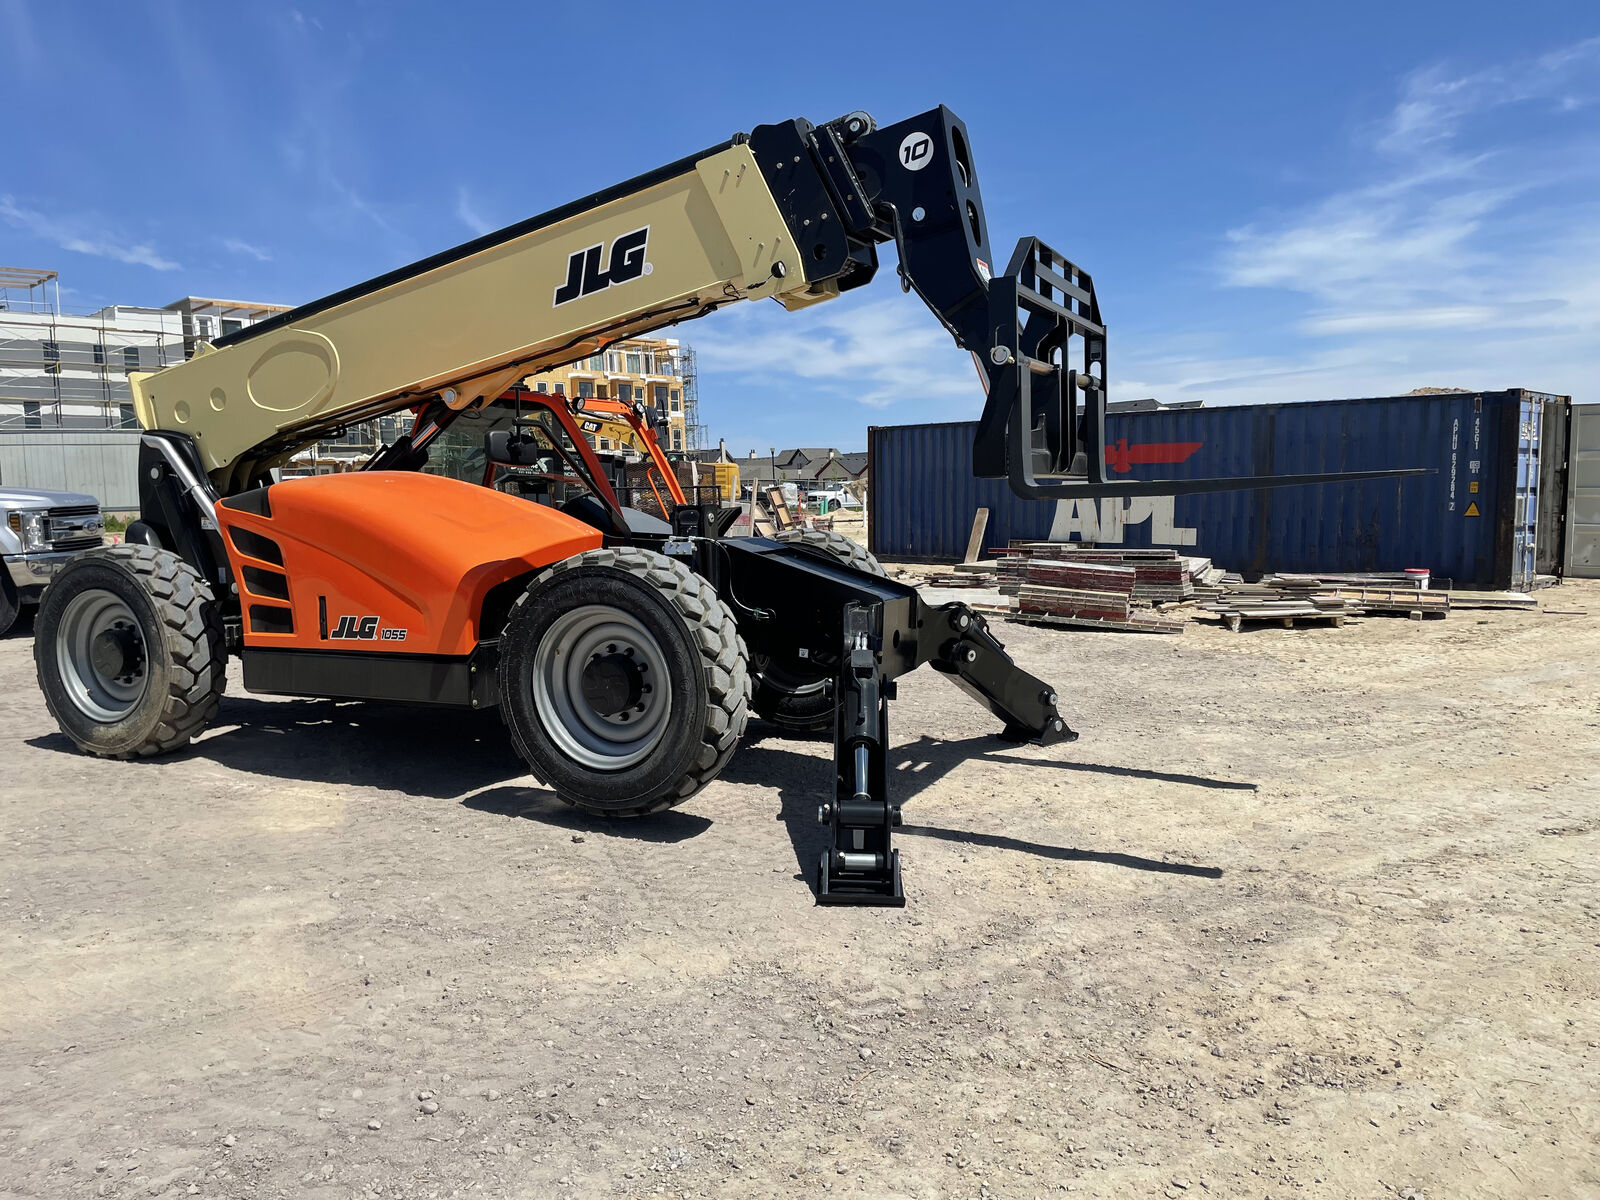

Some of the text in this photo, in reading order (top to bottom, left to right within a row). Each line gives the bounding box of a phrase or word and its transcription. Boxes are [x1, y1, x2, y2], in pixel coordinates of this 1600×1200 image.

[904, 138, 929, 165] 10
[552, 224, 650, 308] JLG
[584, 421, 598, 432] CAT
[1048, 480, 1198, 546] APL
[330, 615, 408, 641] JLG 1055
